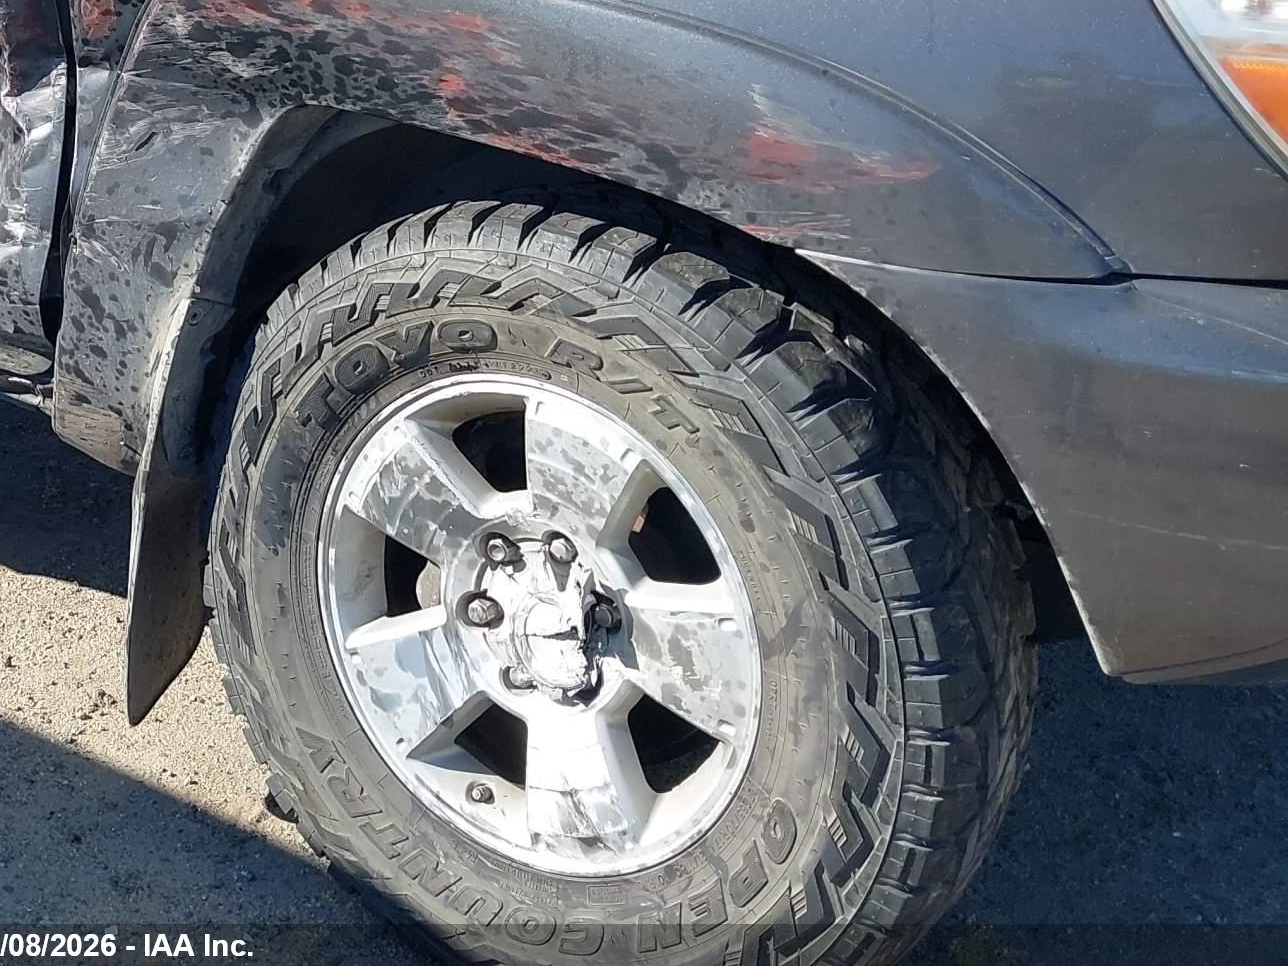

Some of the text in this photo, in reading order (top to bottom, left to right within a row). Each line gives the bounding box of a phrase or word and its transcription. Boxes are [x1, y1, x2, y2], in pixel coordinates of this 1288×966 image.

[294, 317, 701, 435] TOYO R/T
[295, 726, 798, 957] OPEN COUNTRY
